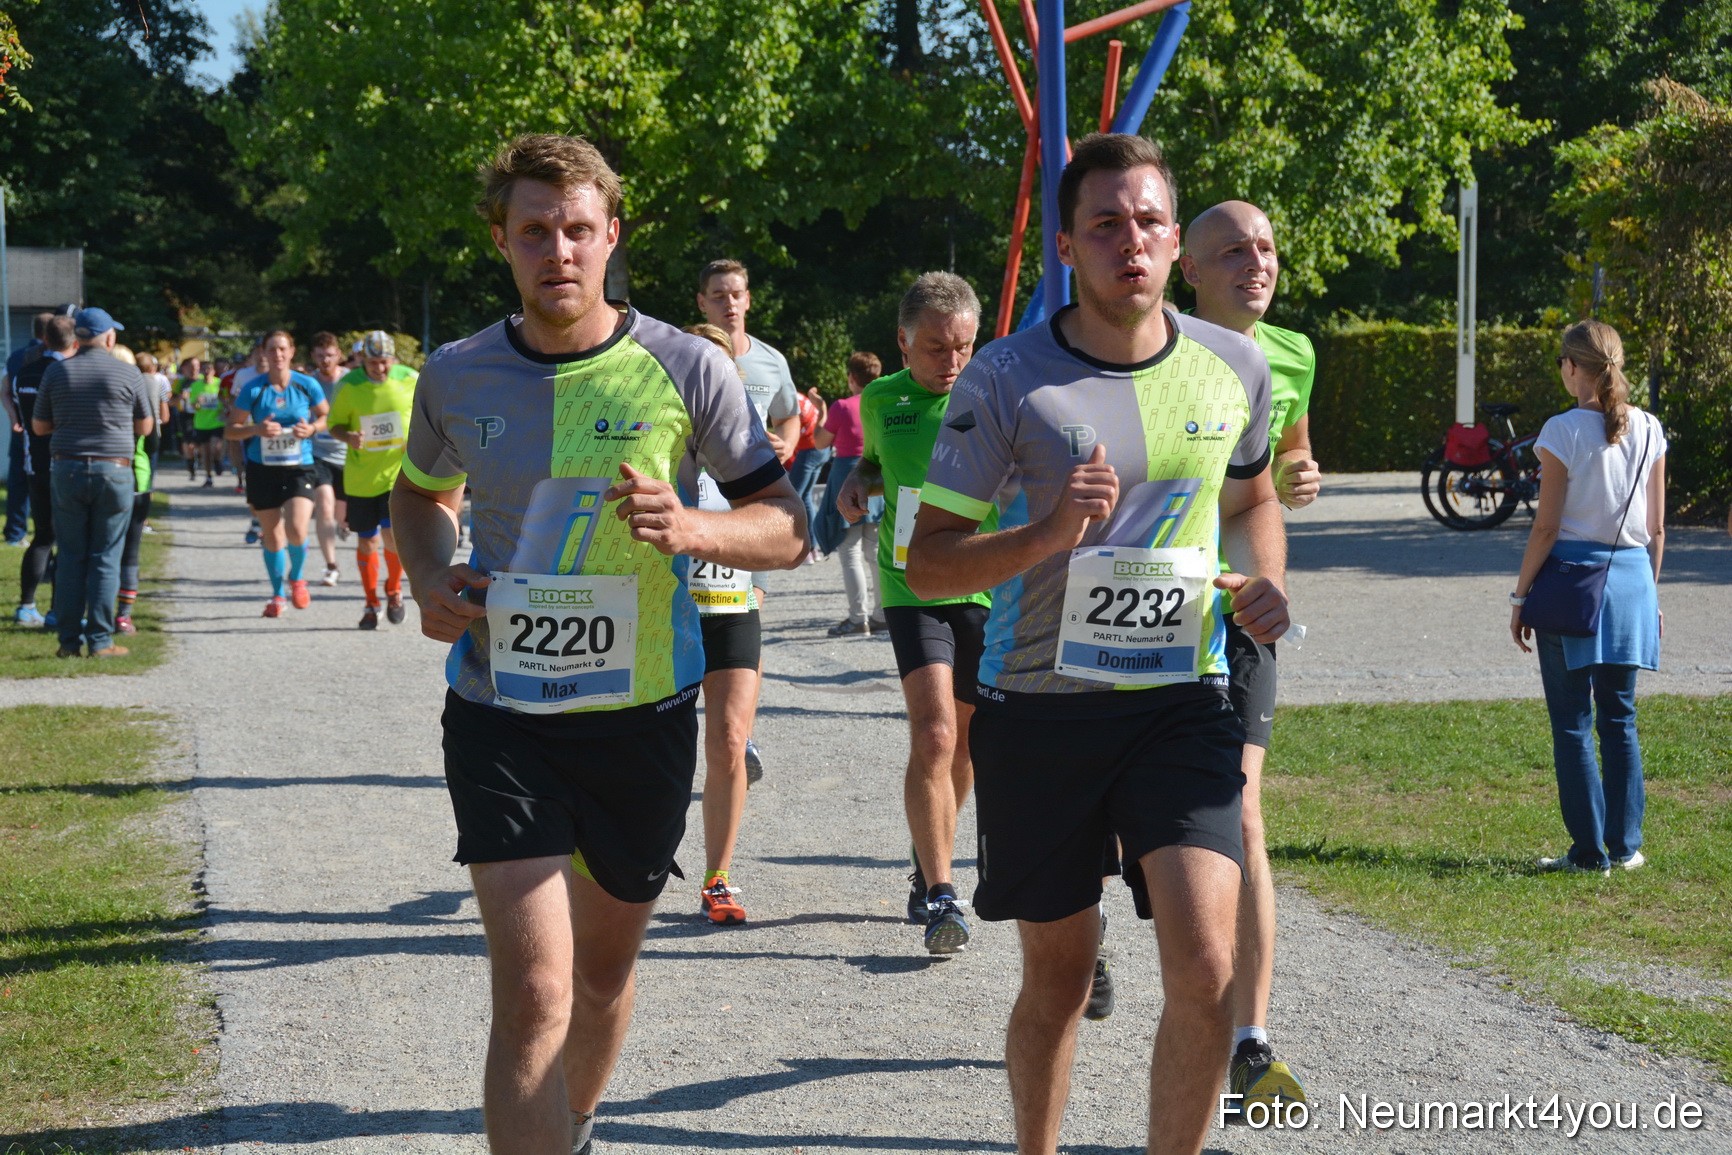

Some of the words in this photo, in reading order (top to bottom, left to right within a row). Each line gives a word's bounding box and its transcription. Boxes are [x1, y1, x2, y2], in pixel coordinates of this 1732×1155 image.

[371, 422, 394, 436] 280
[1113, 560, 1174, 576] BOCK
[529, 588, 593, 604] BOCK
[691, 592, 732, 604] Christine
[1086, 586, 1185, 628] 2232
[1070, 614, 1078, 622] B
[510, 614, 615, 657] 2220
[1093, 632, 1124, 642] PARTL
[1126, 635, 1164, 643] Neumarkt
[519, 660, 548, 671] PARTL
[549, 661, 592, 672] Neumarkt
[1097, 651, 1164, 669] Dominik
[542, 682, 578, 698] Max
